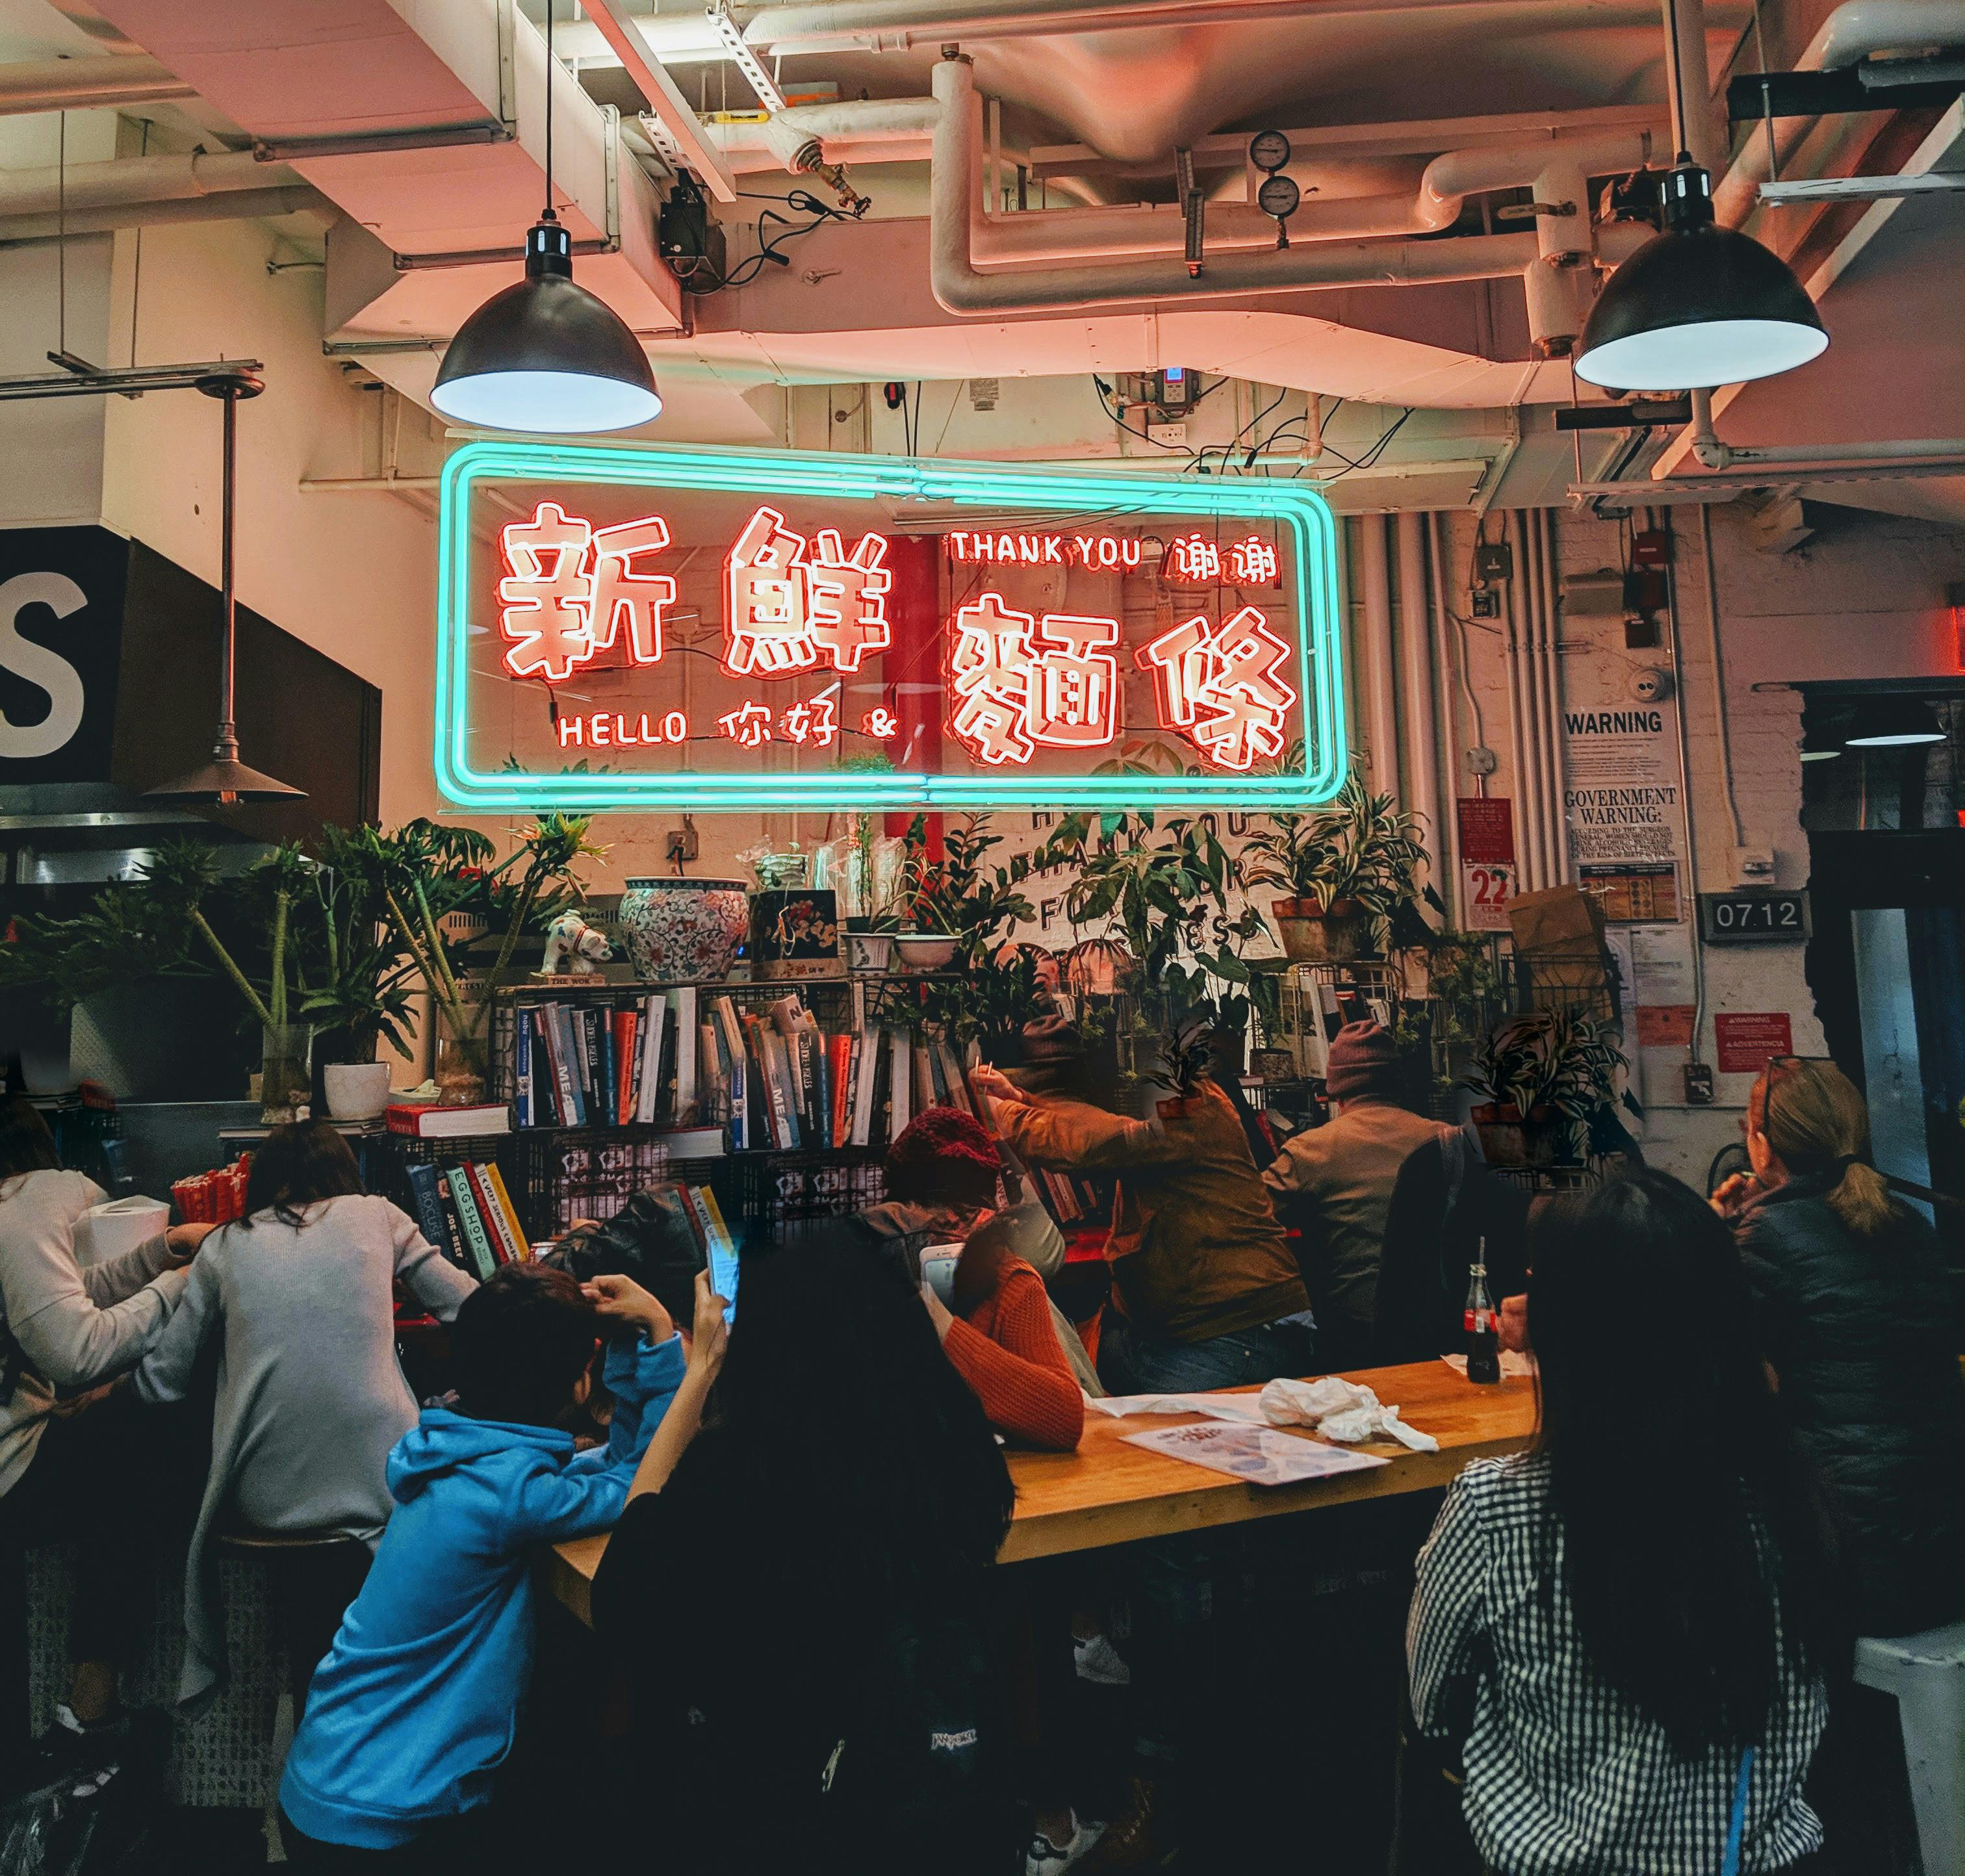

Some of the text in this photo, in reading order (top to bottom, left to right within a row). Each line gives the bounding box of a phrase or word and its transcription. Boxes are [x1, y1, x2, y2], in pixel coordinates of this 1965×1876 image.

[950, 531, 1141, 566] THANK YOU
[1172, 532, 1278, 583] 谢谢
[558, 711, 687, 747] HELLO
[717, 697, 840, 747] 你好
[871, 707, 898, 738] &
[1565, 711, 1663, 735] WARNING
[1564, 788, 1676, 808] GOVERNMENT
[1580, 806, 1662, 825] WARNING:
[1471, 869, 1508, 905] 22
[484, 1184, 496, 1201] VERY
[422, 1190, 441, 1238] BOCUSE
[446, 1213, 463, 1259] JOE BEEF
